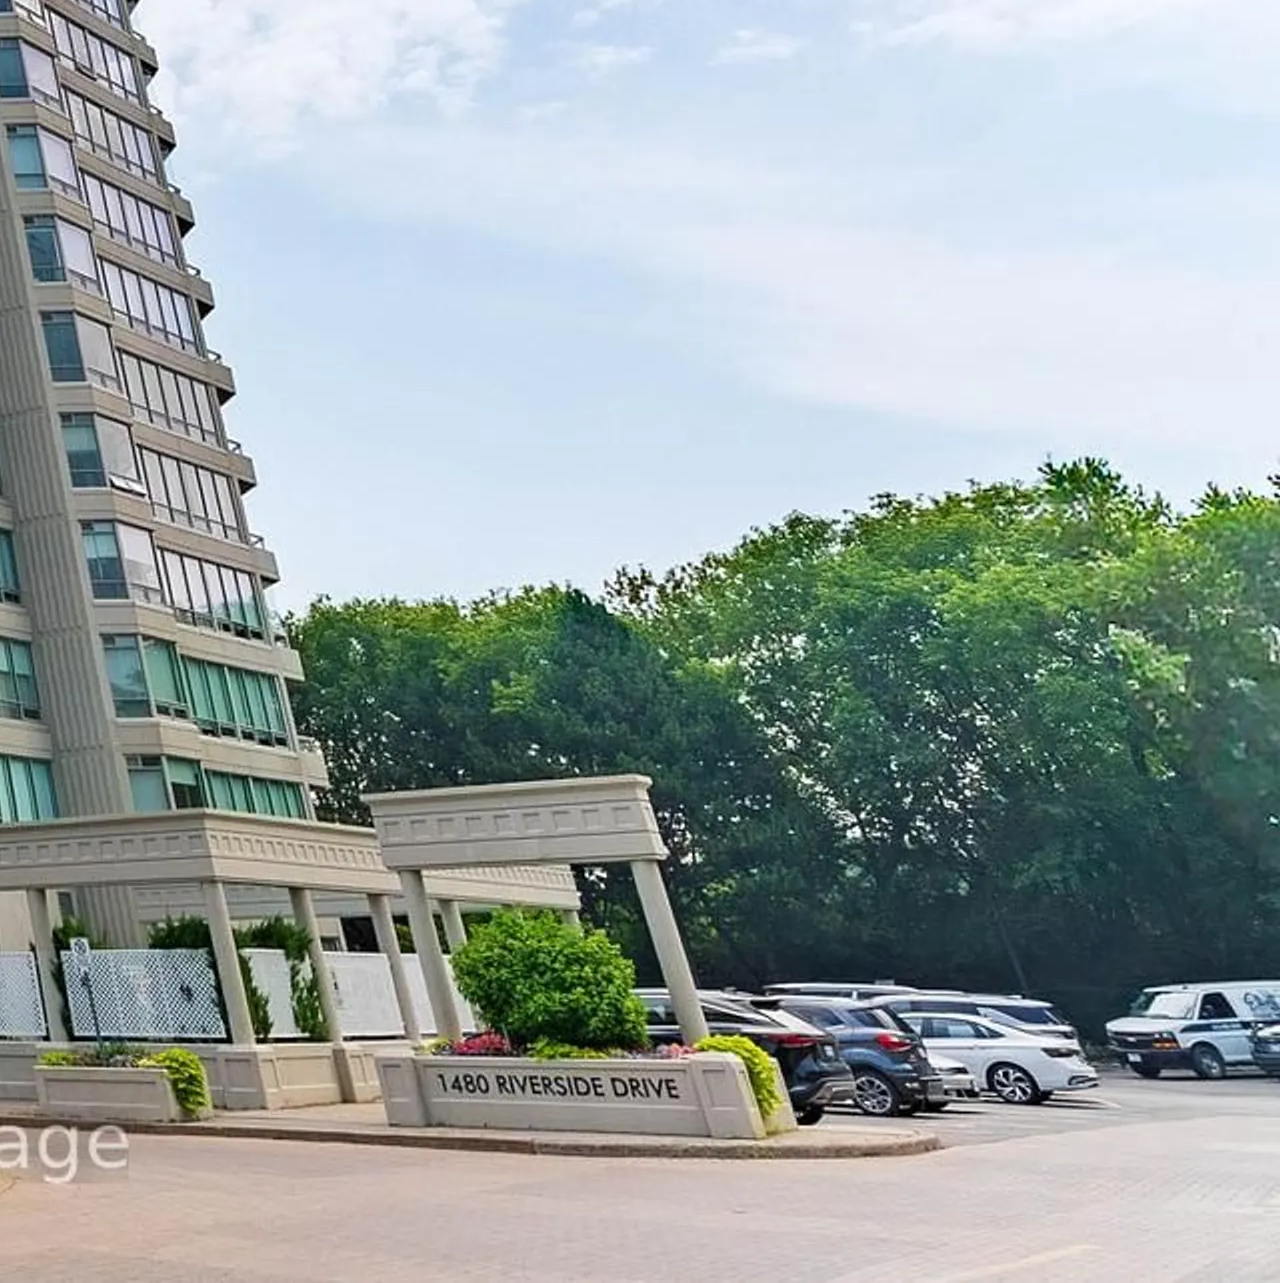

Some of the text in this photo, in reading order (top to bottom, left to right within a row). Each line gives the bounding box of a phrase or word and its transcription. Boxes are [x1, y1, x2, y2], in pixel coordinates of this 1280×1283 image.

[437, 1073, 680, 1099] 1480 RIVERSIDE DRIVE
